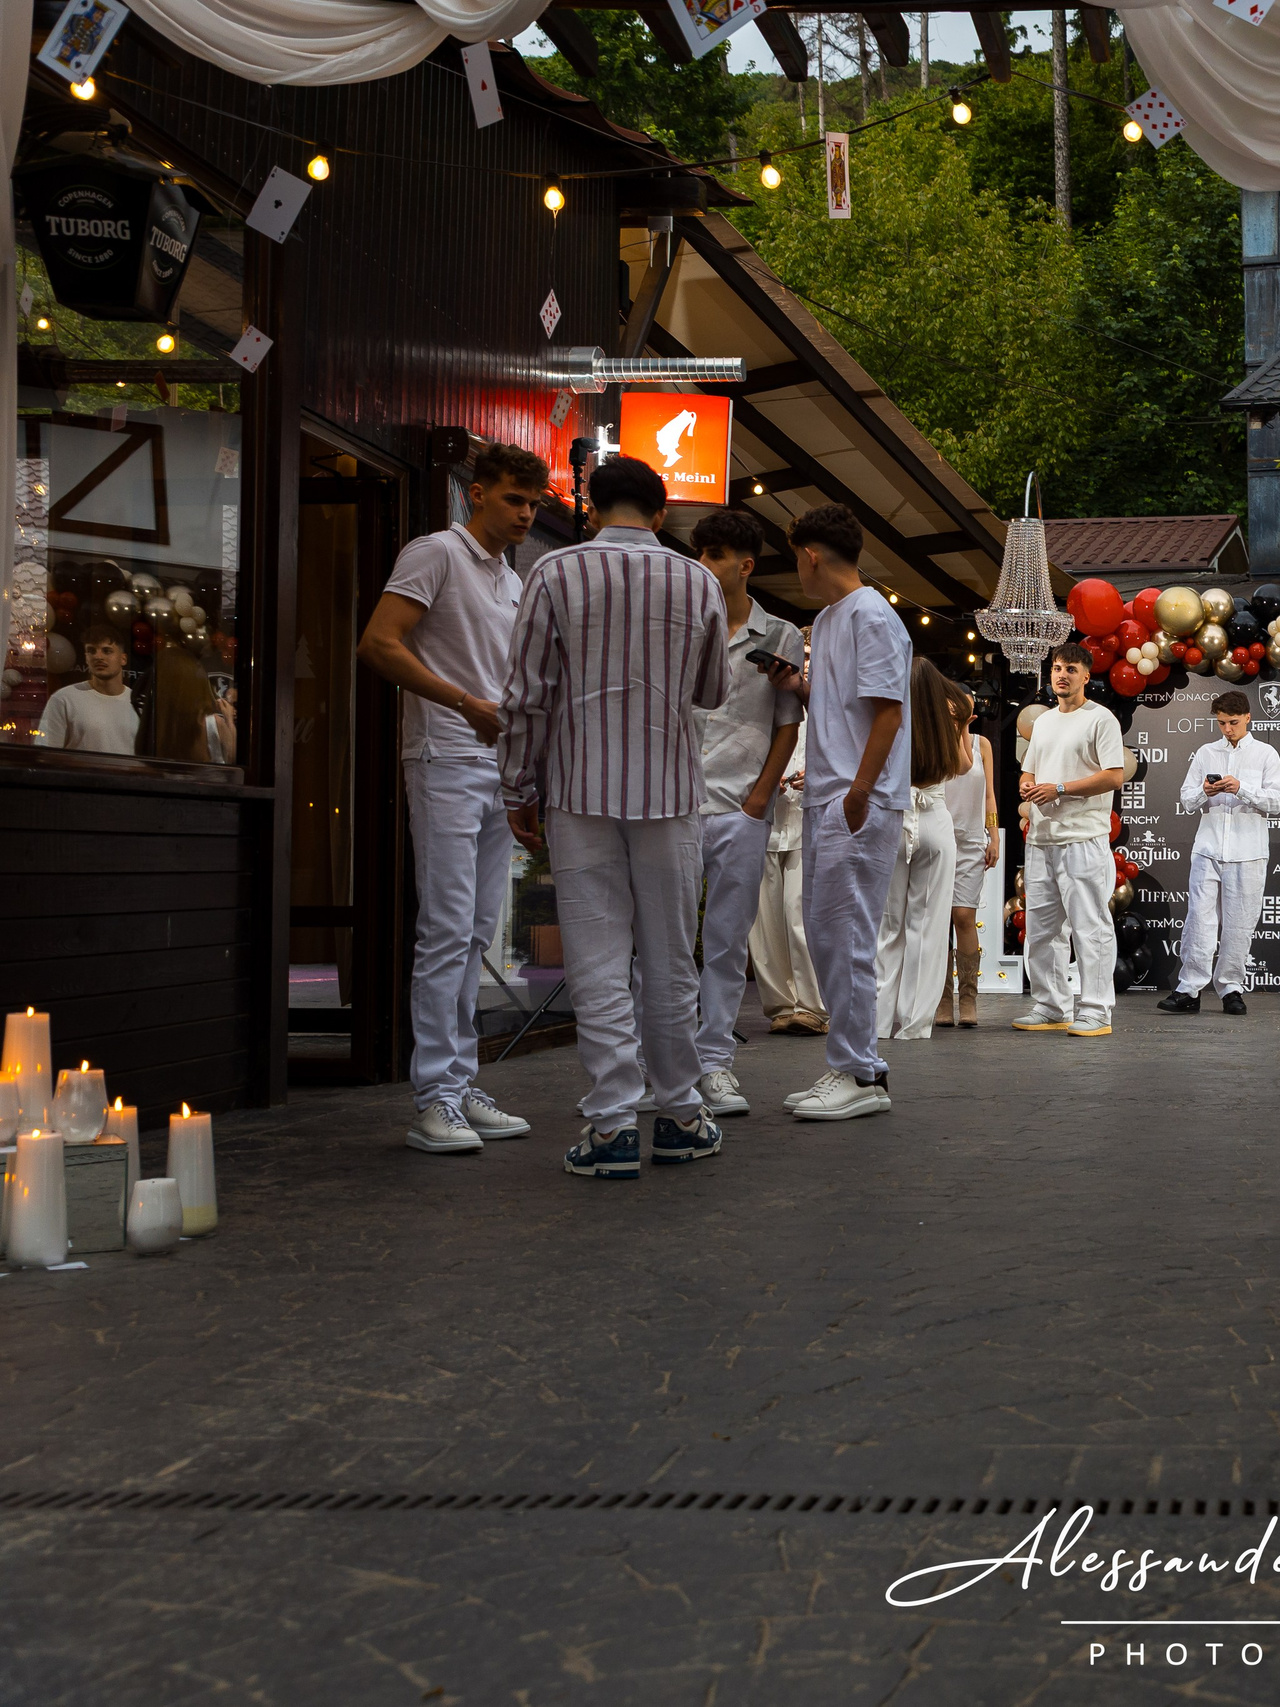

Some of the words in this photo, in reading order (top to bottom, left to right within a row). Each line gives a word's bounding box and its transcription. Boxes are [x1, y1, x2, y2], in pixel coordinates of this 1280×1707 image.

[57, 189, 114, 208] COPENHAGEN
[45, 215, 131, 240] TUBORG
[150, 226, 188, 264] TUBORG
[67, 248, 94, 264] SINCE
[674, 472, 716, 484] Meinl
[1167, 717, 1218, 733] LOFT
